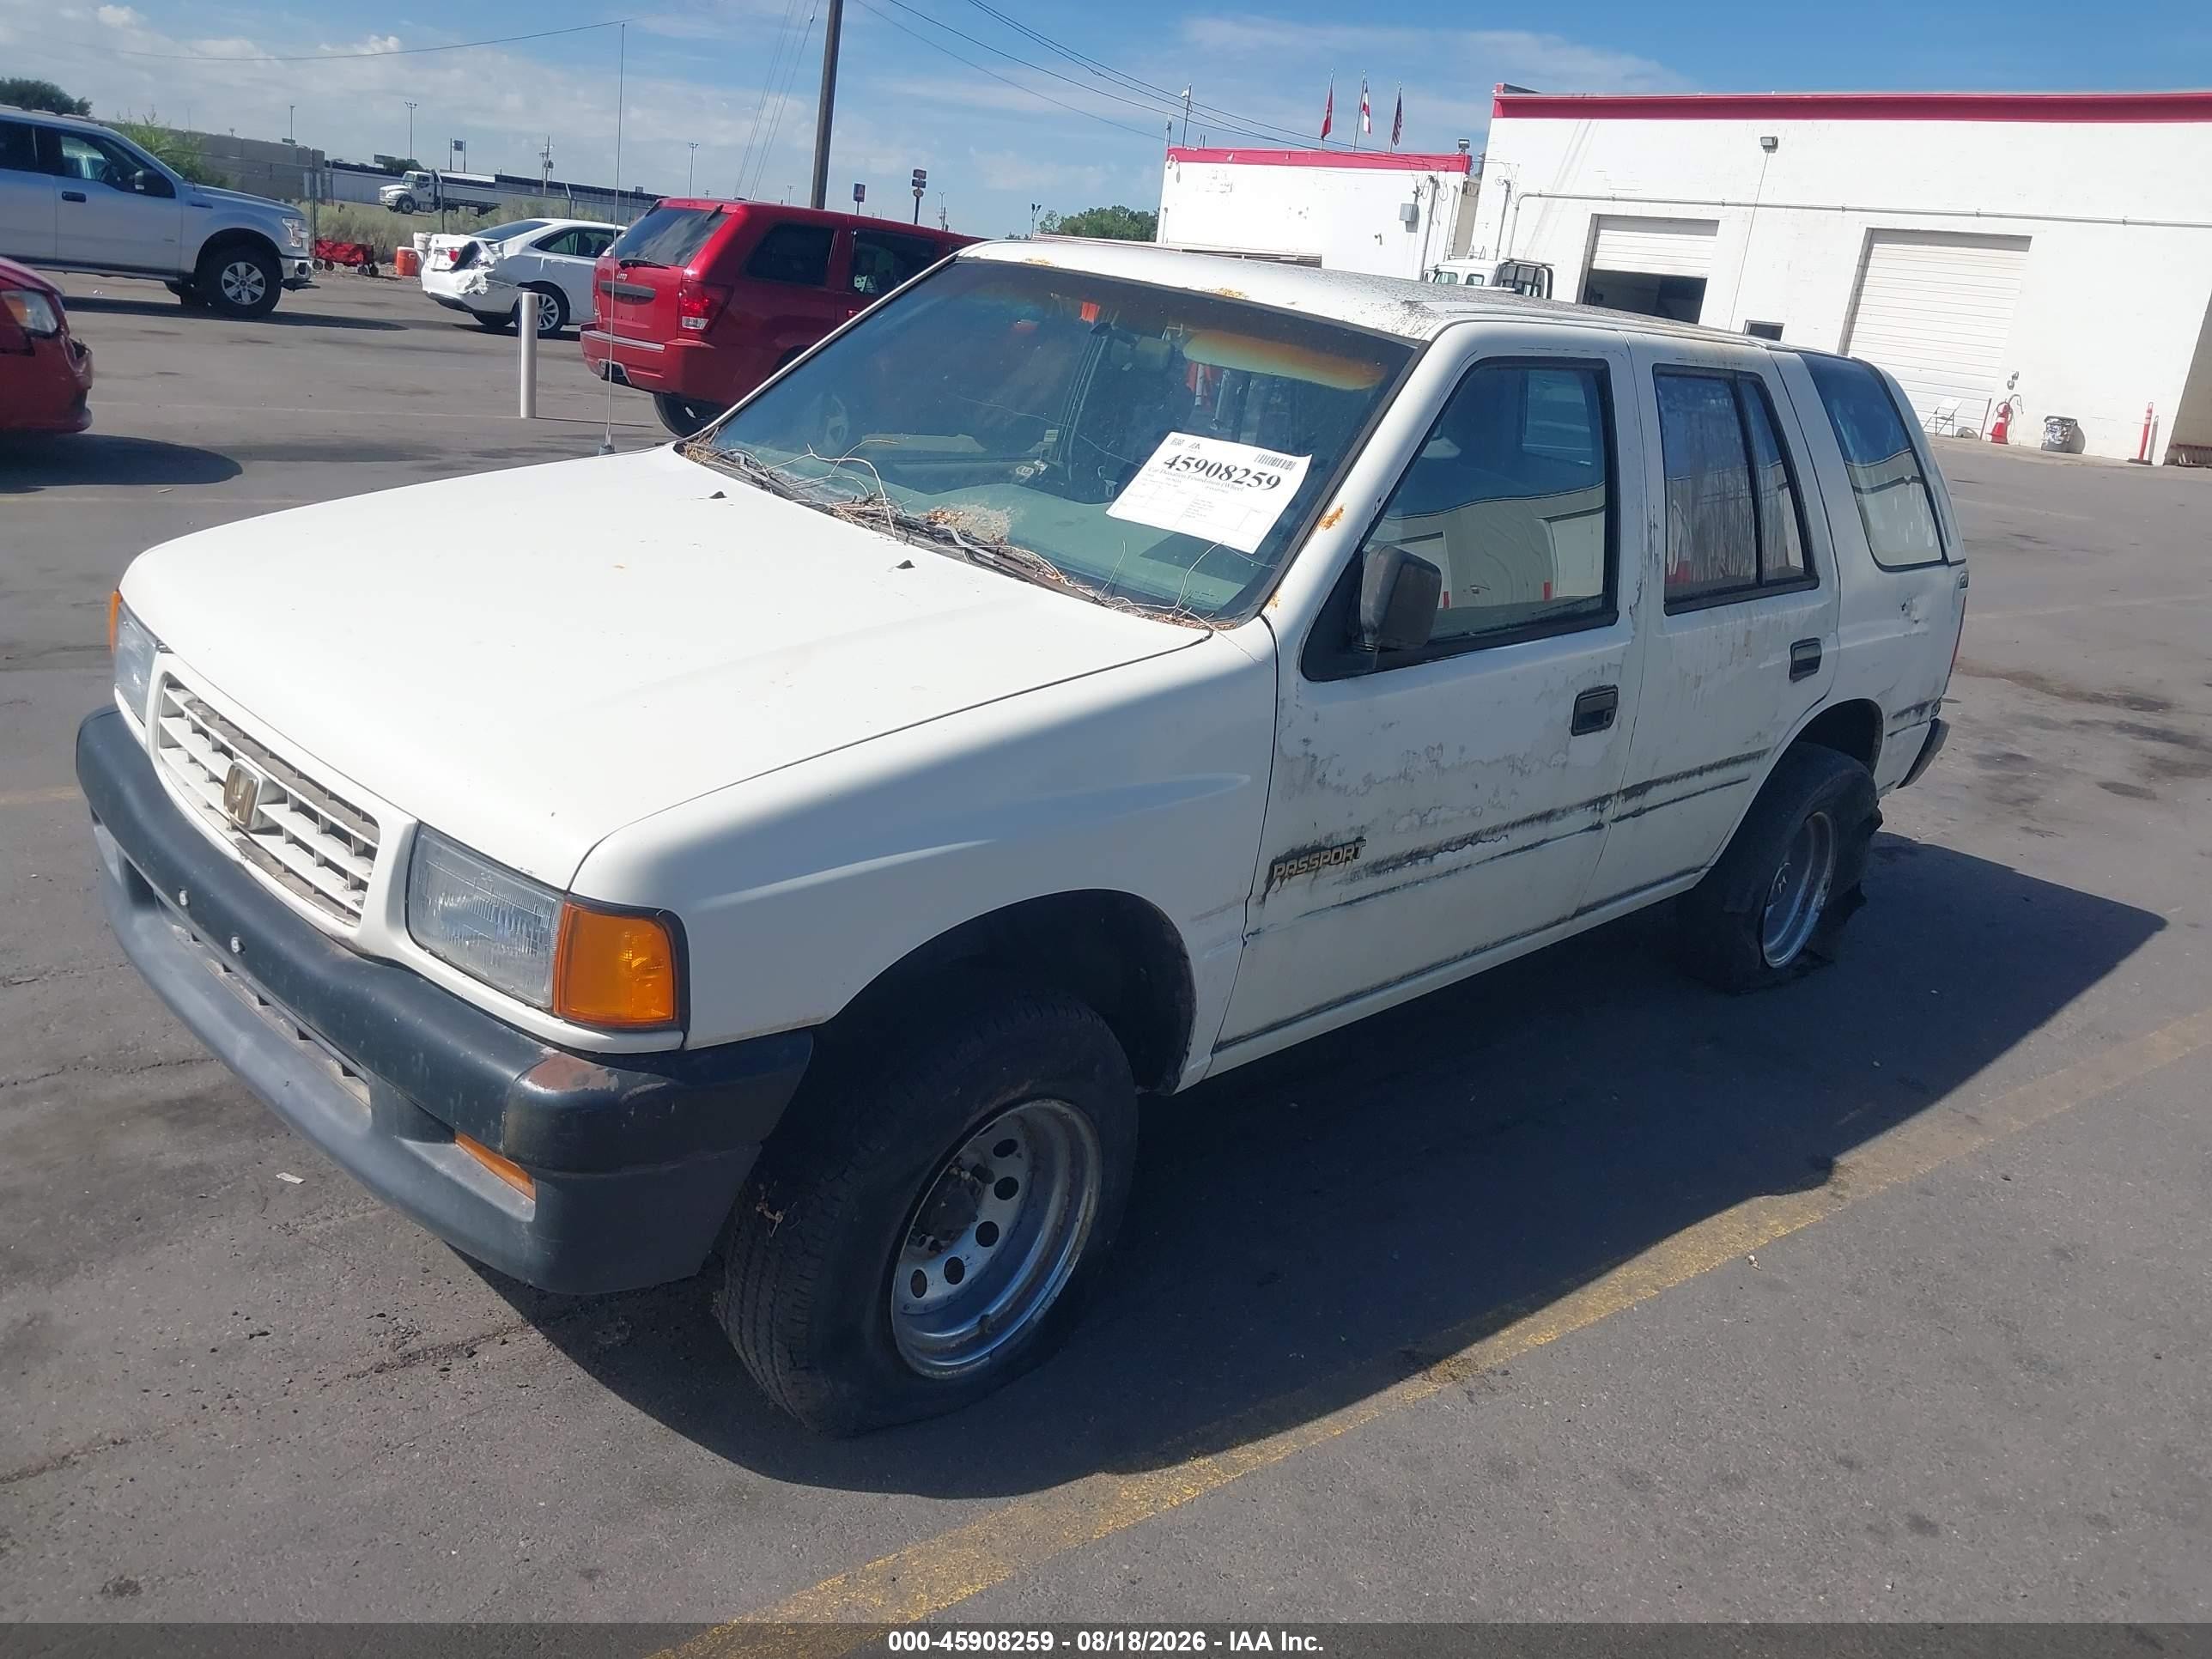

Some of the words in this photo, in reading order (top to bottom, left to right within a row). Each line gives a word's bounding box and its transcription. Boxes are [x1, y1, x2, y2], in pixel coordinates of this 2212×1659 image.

[616, 270, 628, 283] Jeep
[1164, 454, 1281, 490] 45908259
[1274, 841, 1367, 878] PASSPORT
